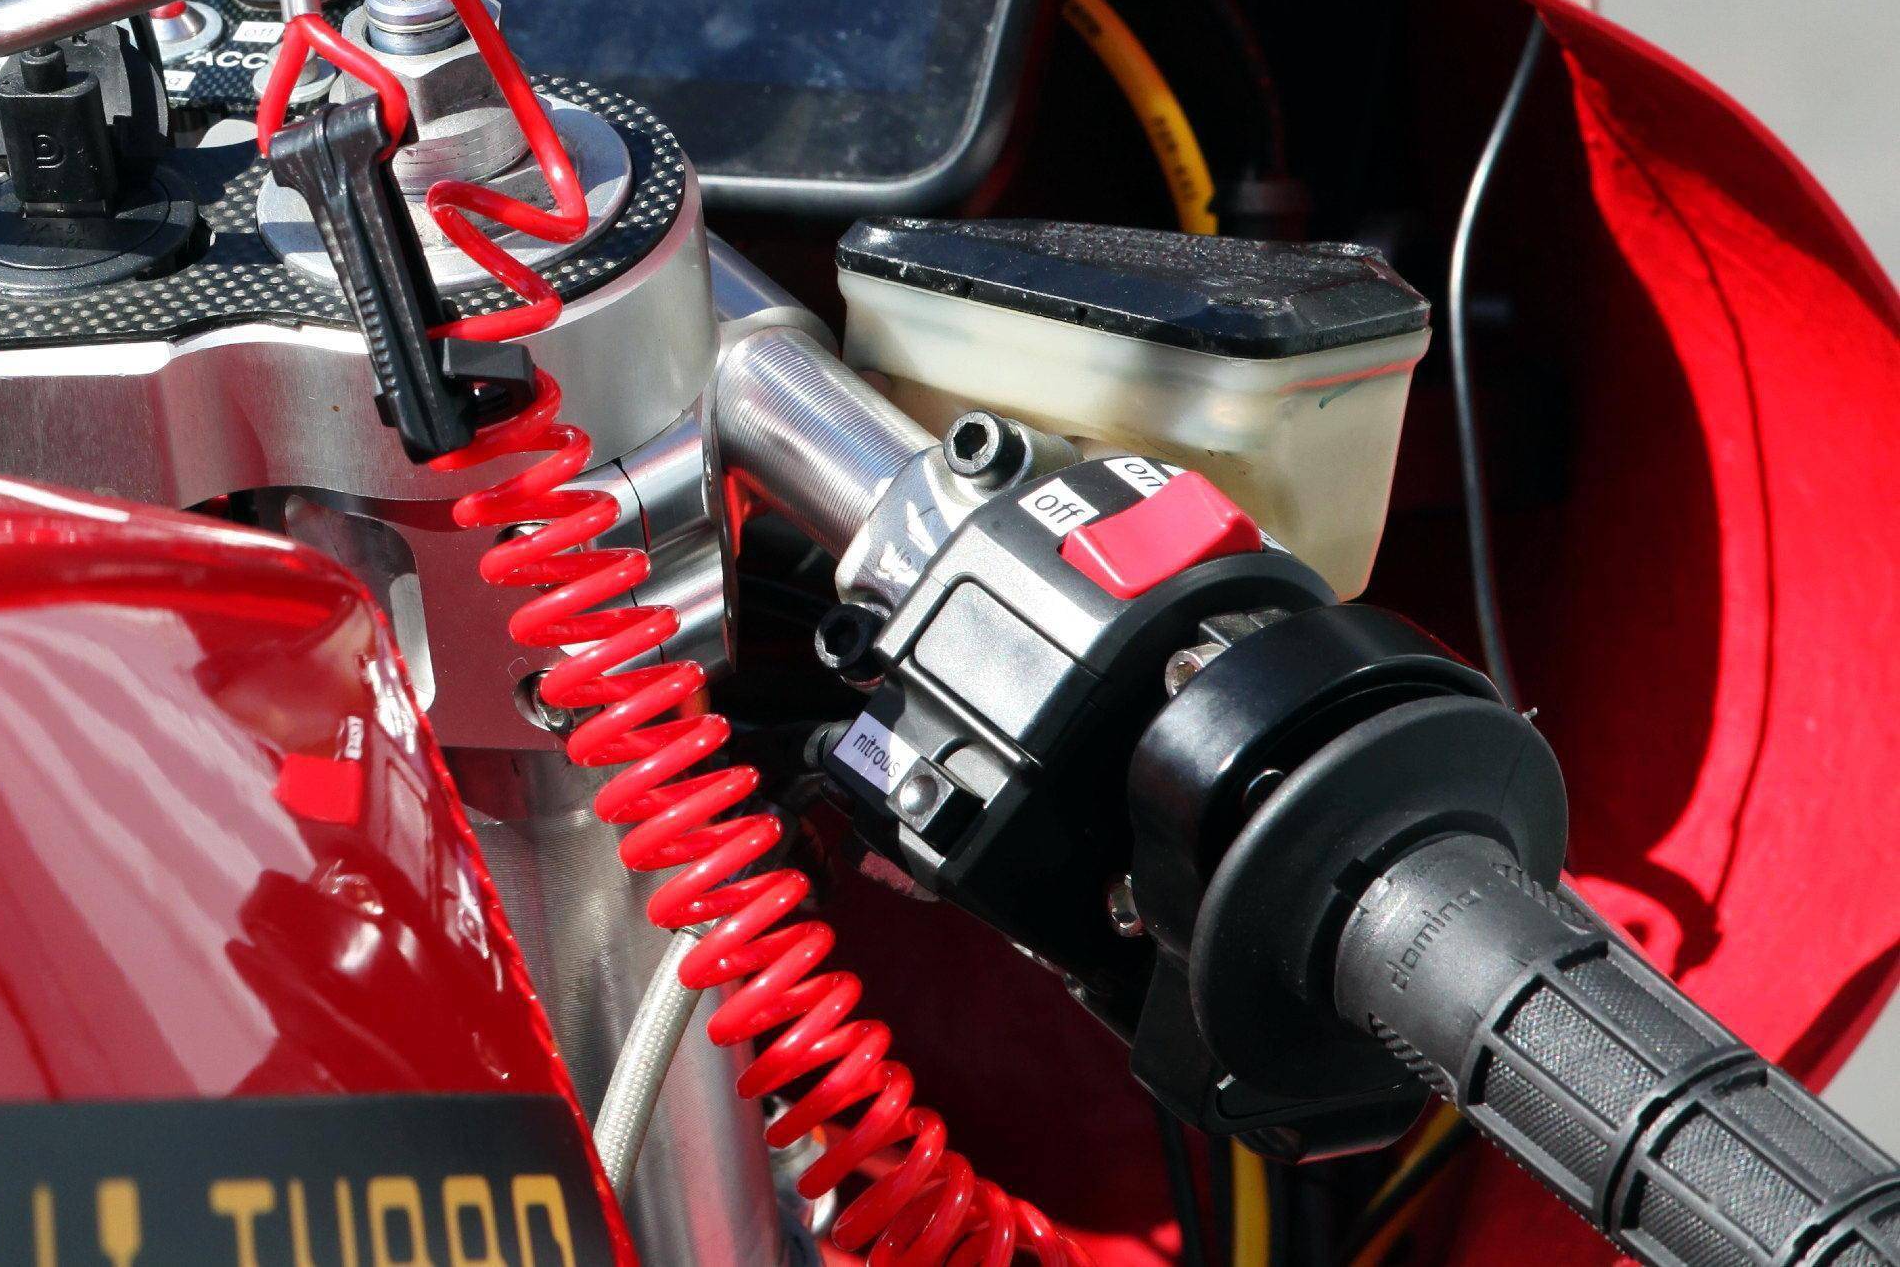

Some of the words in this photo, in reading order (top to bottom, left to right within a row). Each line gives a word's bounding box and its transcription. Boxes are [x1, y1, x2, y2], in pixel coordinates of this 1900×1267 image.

[1124, 463, 1163, 487] on
[1034, 494, 1086, 524] off
[852, 732, 901, 778] nitrous
[1386, 890, 1481, 991] domino
